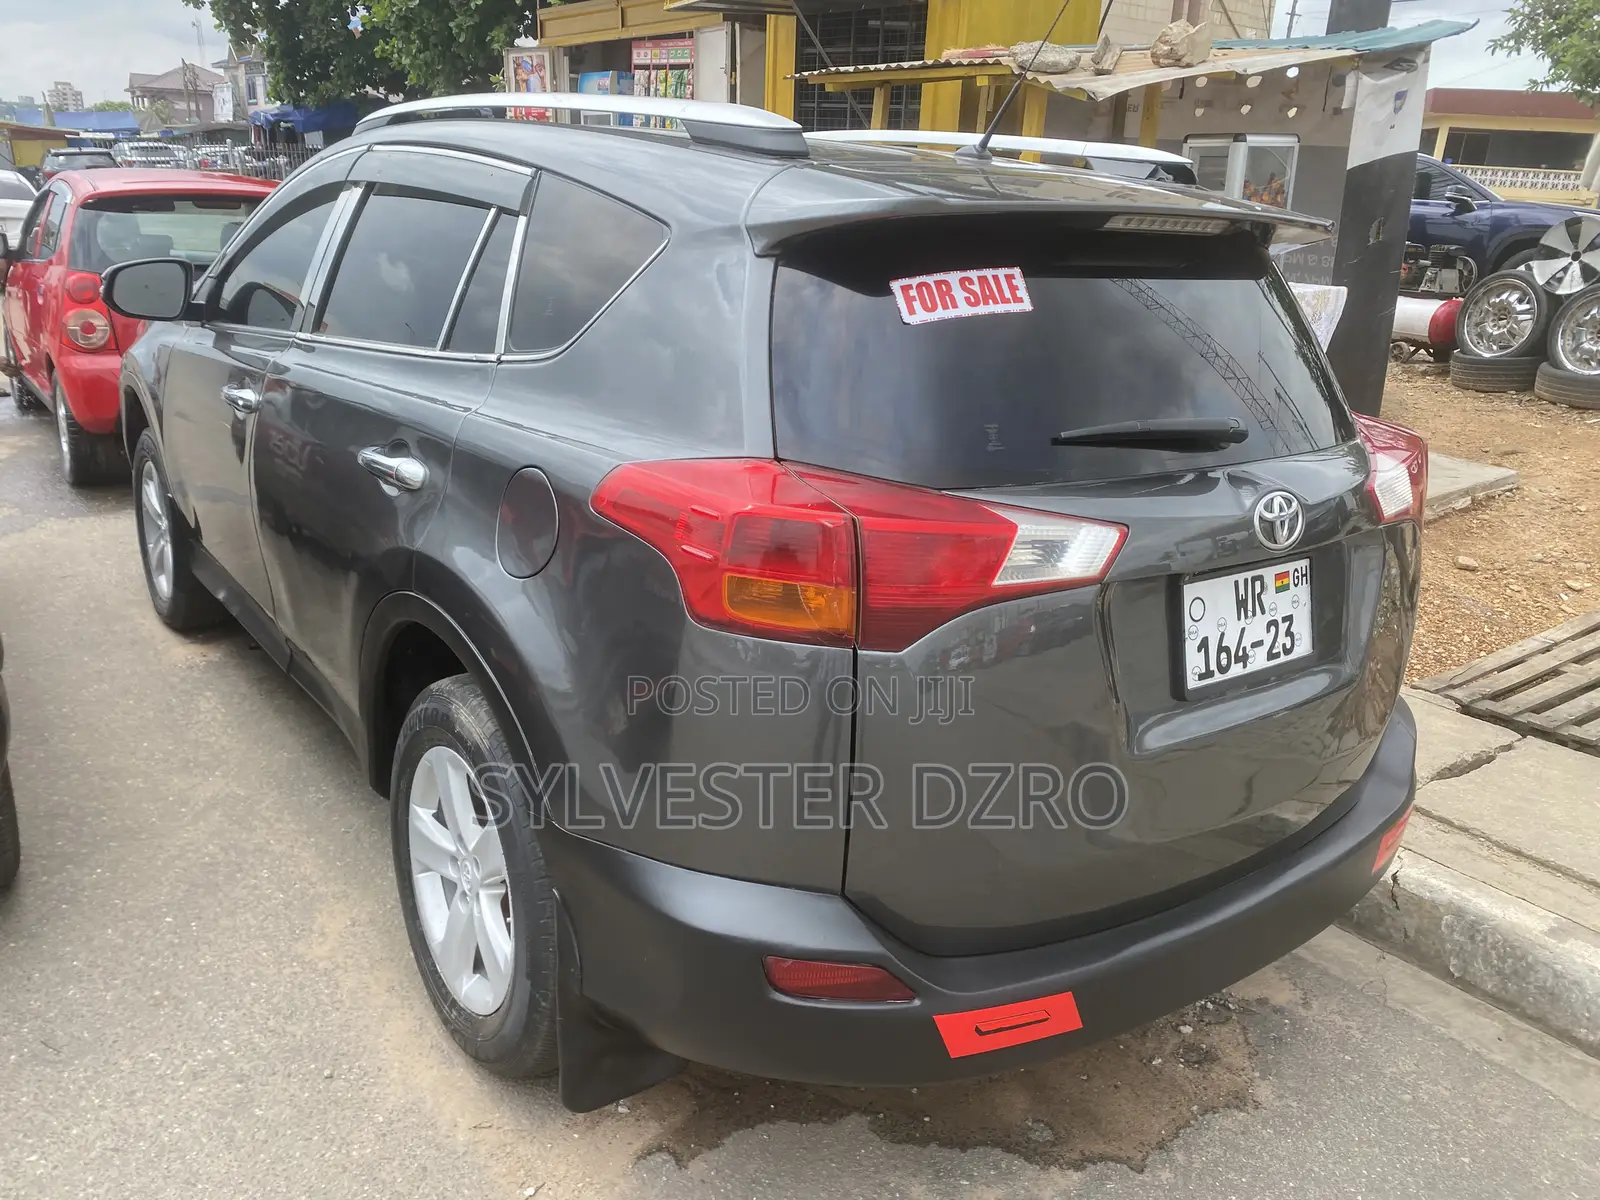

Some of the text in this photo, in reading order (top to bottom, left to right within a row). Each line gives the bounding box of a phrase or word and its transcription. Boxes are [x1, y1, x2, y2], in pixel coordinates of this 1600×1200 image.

[900, 273, 1025, 316] FOR SALE
[1234, 565, 1309, 621] WR GH
[1197, 614, 1295, 681] 164-23
